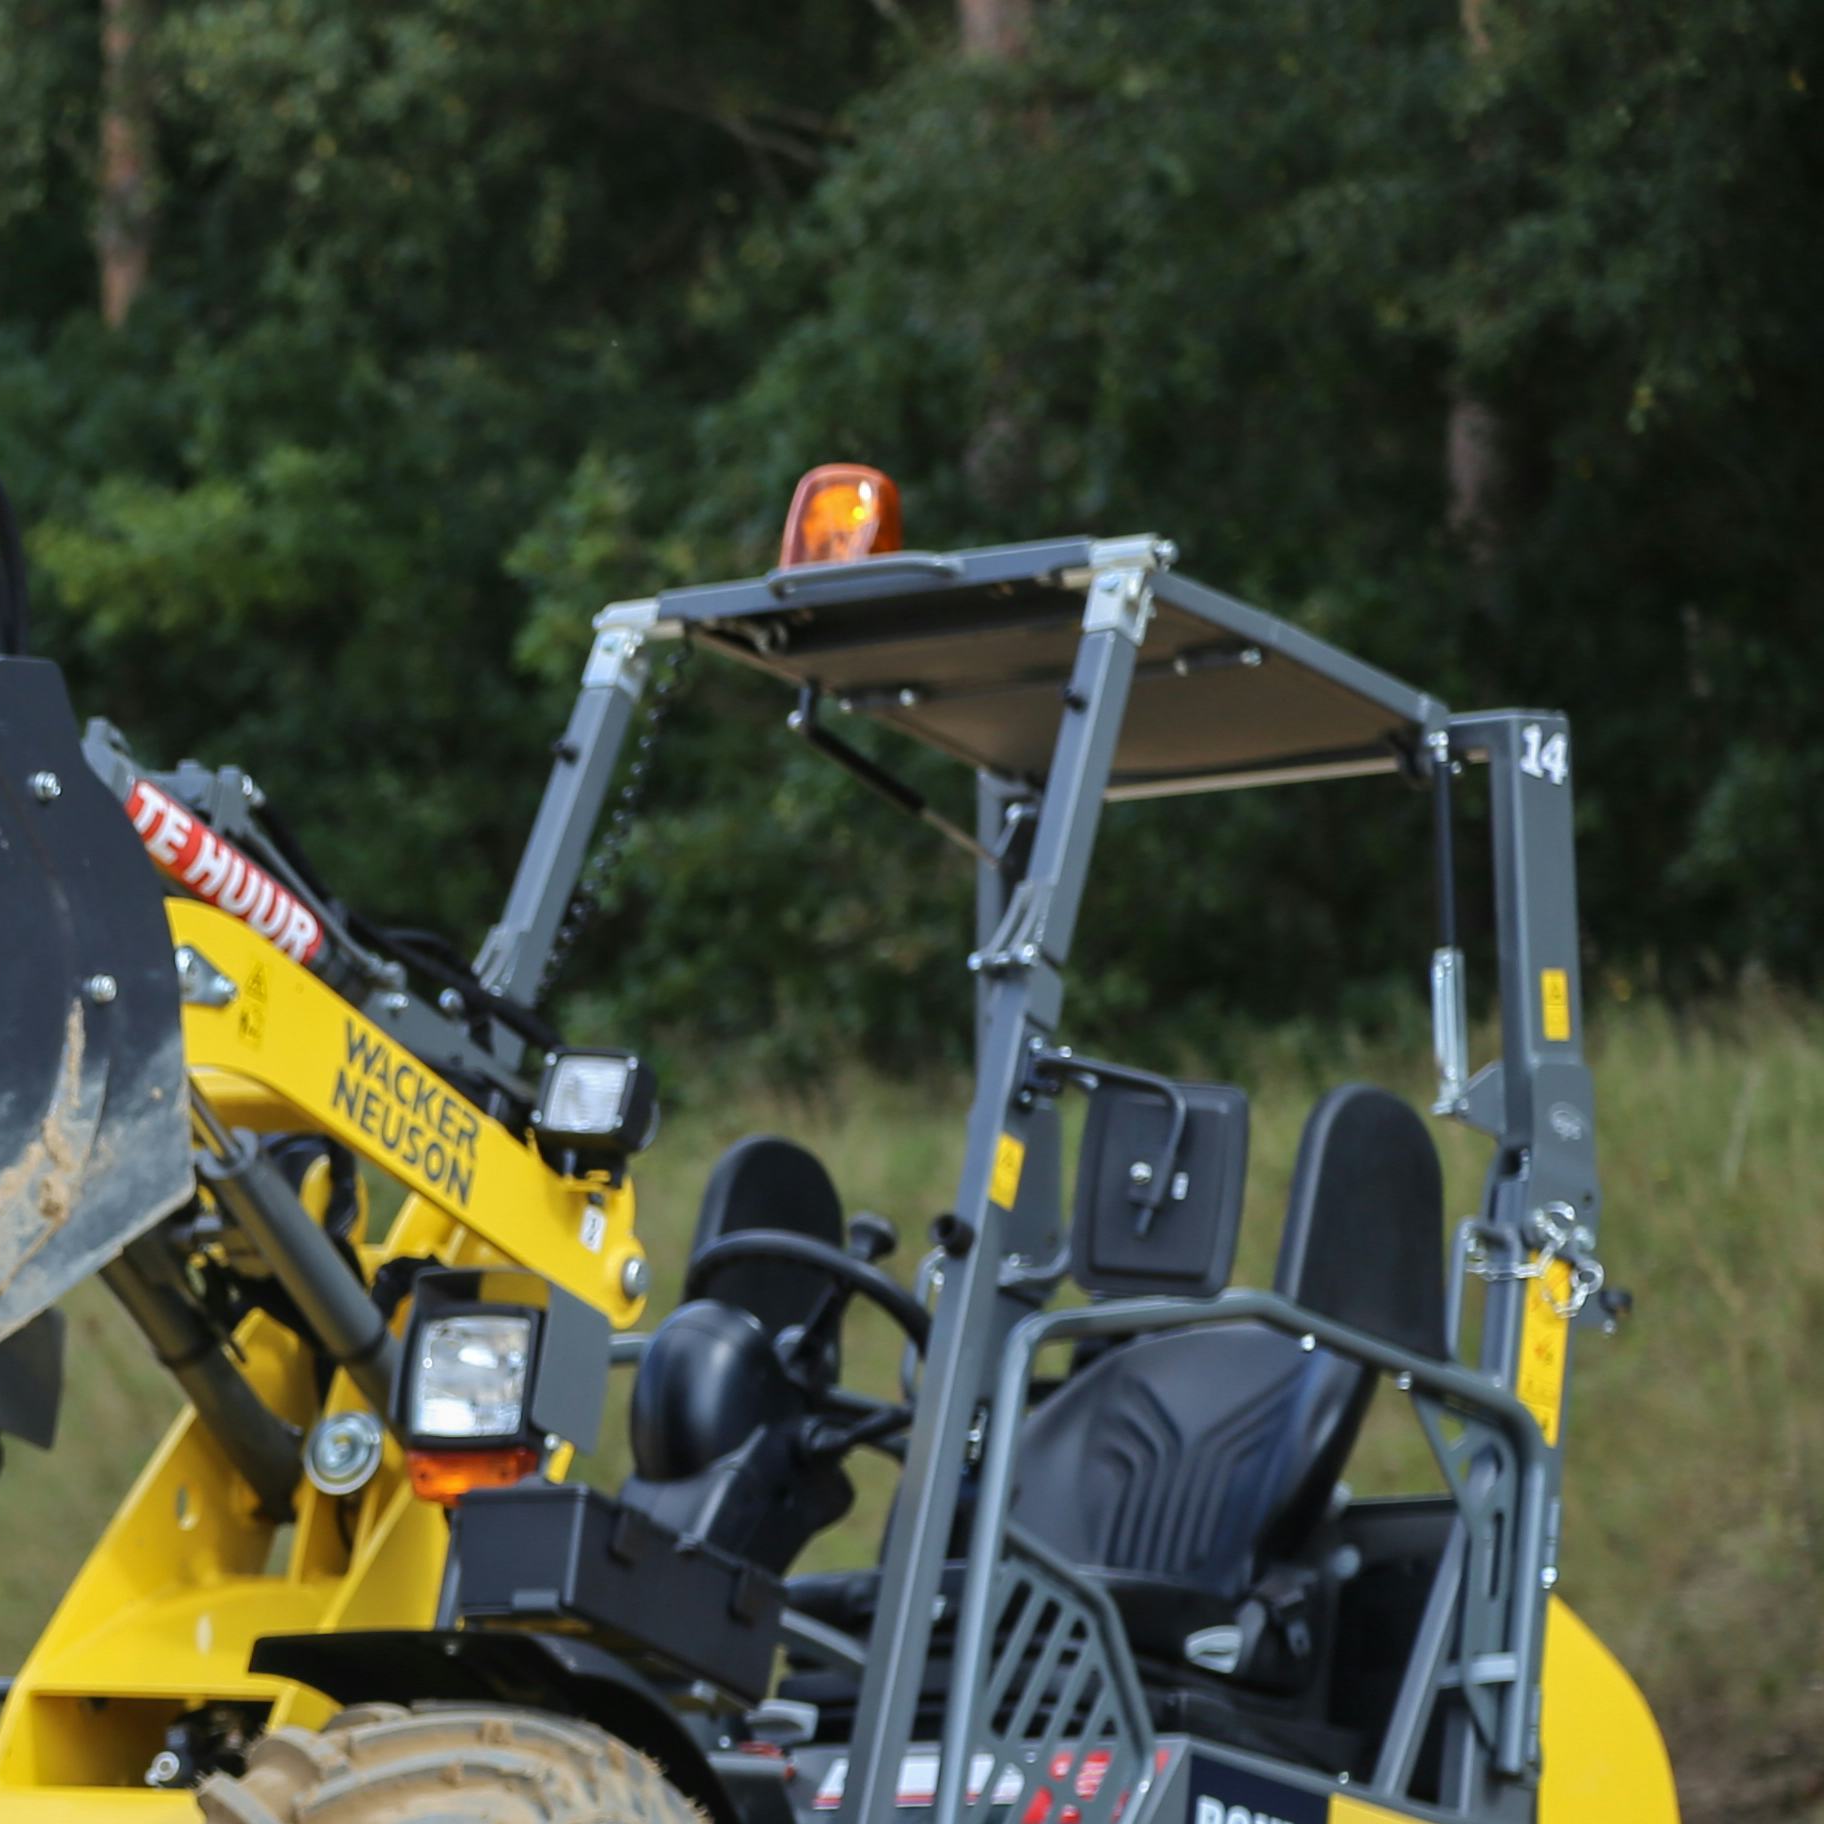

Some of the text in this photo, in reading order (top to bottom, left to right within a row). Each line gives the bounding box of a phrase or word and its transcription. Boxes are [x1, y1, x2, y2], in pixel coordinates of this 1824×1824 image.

[1520, 723, 1569, 786] 14
[133, 783, 318, 962] TE HUUR
[332, 1068, 474, 1206] NEUSON
[345, 1018, 479, 1160] WACKER
